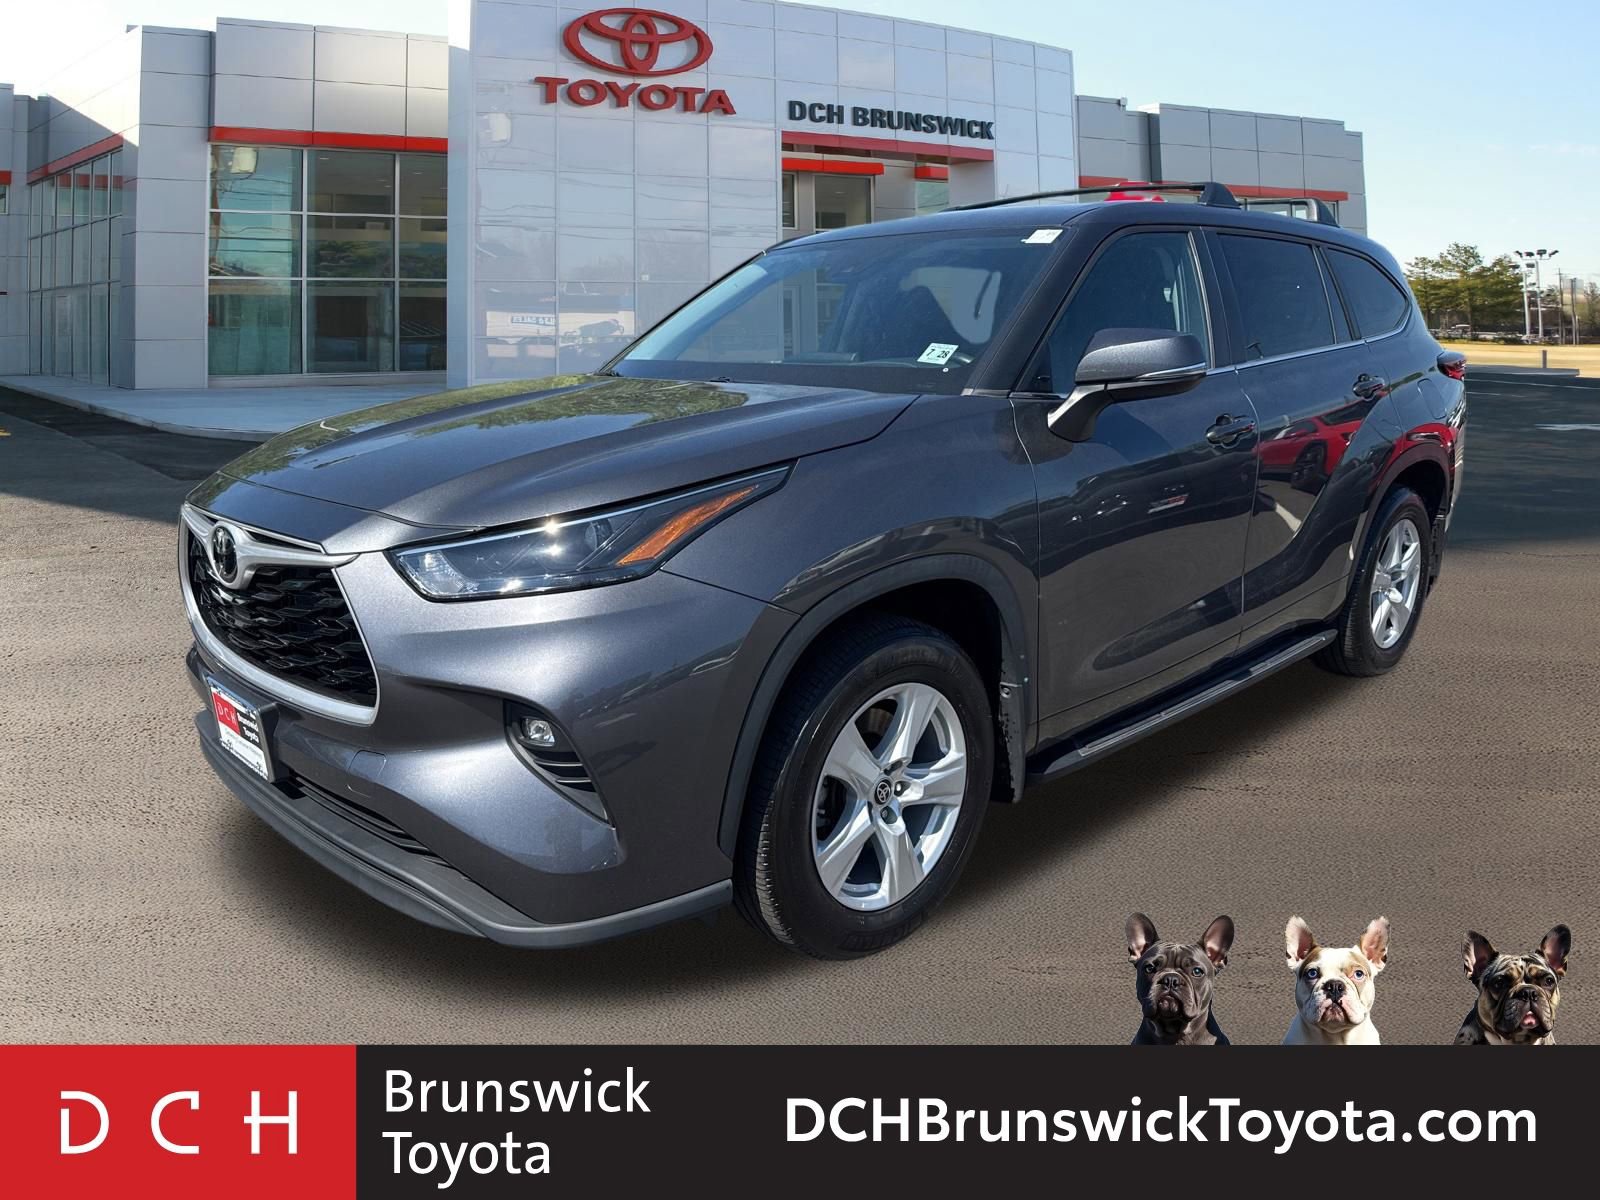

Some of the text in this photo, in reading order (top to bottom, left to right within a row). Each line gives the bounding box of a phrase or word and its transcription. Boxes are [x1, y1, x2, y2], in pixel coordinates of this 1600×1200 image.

[534, 76, 736, 115] TOYOTA
[788, 100, 994, 140] DCH BRUNSWICK
[926, 348, 935, 357] 7
[217, 702, 238, 725] DCH
